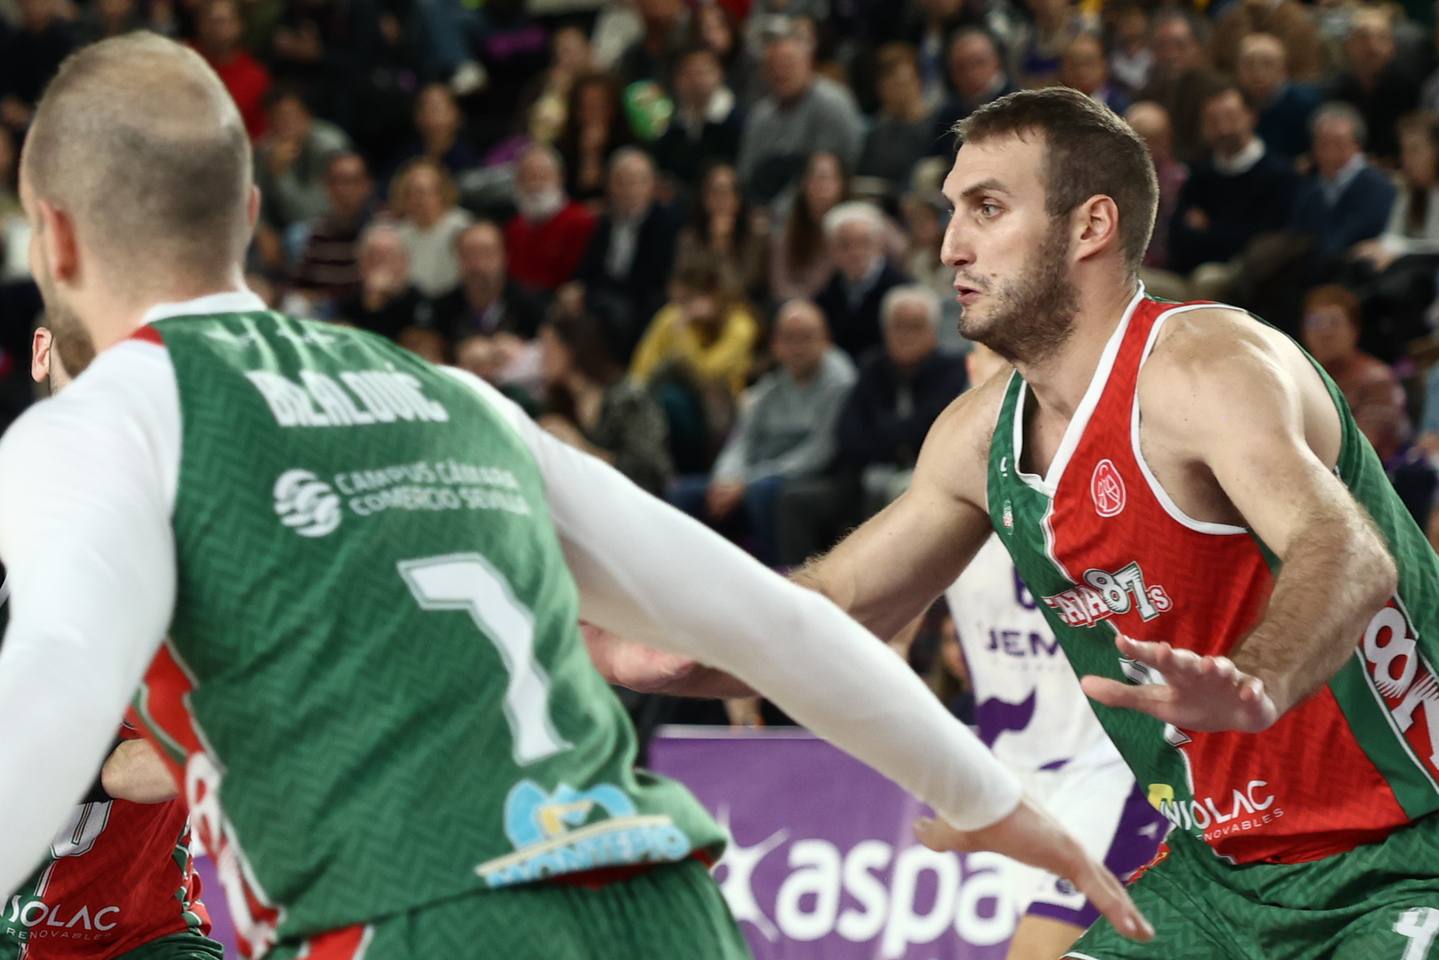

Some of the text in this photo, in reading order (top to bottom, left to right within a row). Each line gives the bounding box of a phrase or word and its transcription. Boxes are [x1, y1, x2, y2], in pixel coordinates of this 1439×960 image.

[334, 460, 436, 495] CAMPUS
[348, 484, 461, 516] COMERCIO
[398, 552, 574, 767] 7
